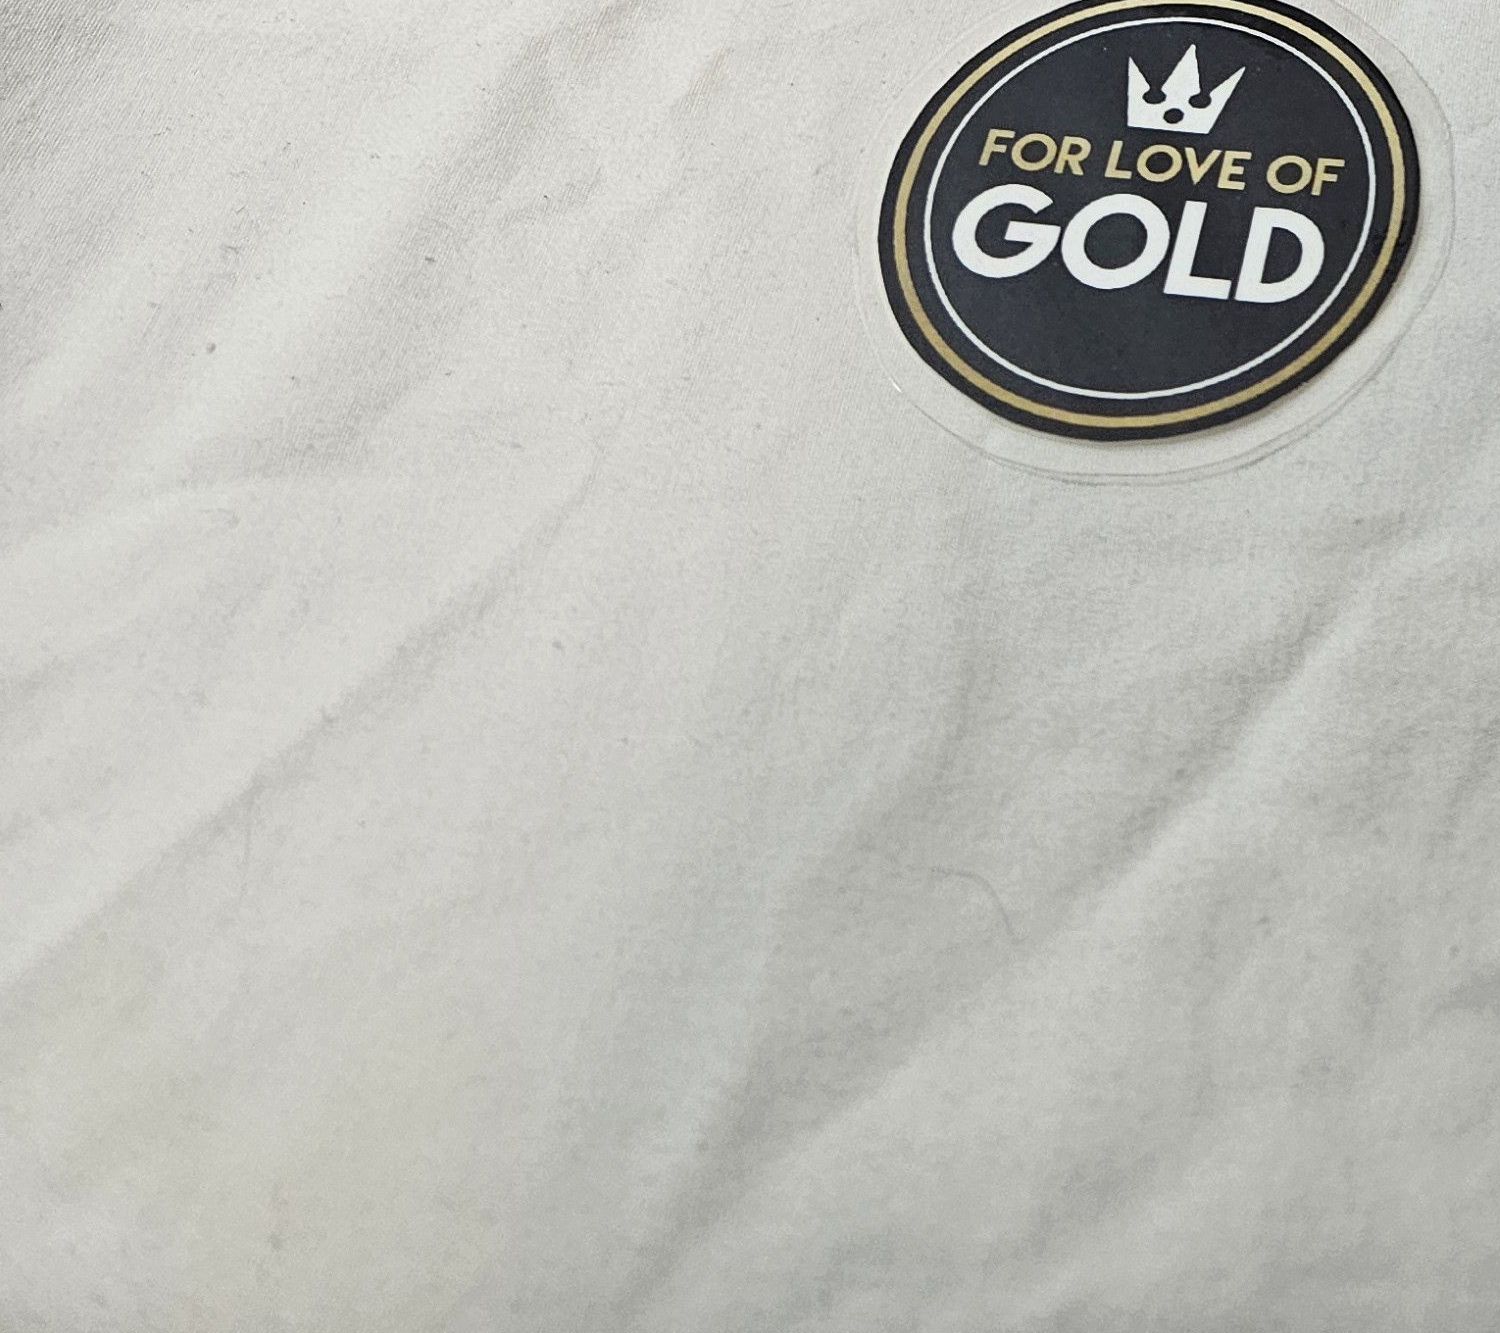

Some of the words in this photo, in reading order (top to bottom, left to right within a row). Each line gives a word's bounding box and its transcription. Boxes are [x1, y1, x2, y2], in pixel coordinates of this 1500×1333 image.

[978, 129, 1091, 176] FOR
[1105, 141, 1252, 190] LOVE
[1266, 155, 1345, 196] OF
[952, 183, 1325, 304] GOLD
